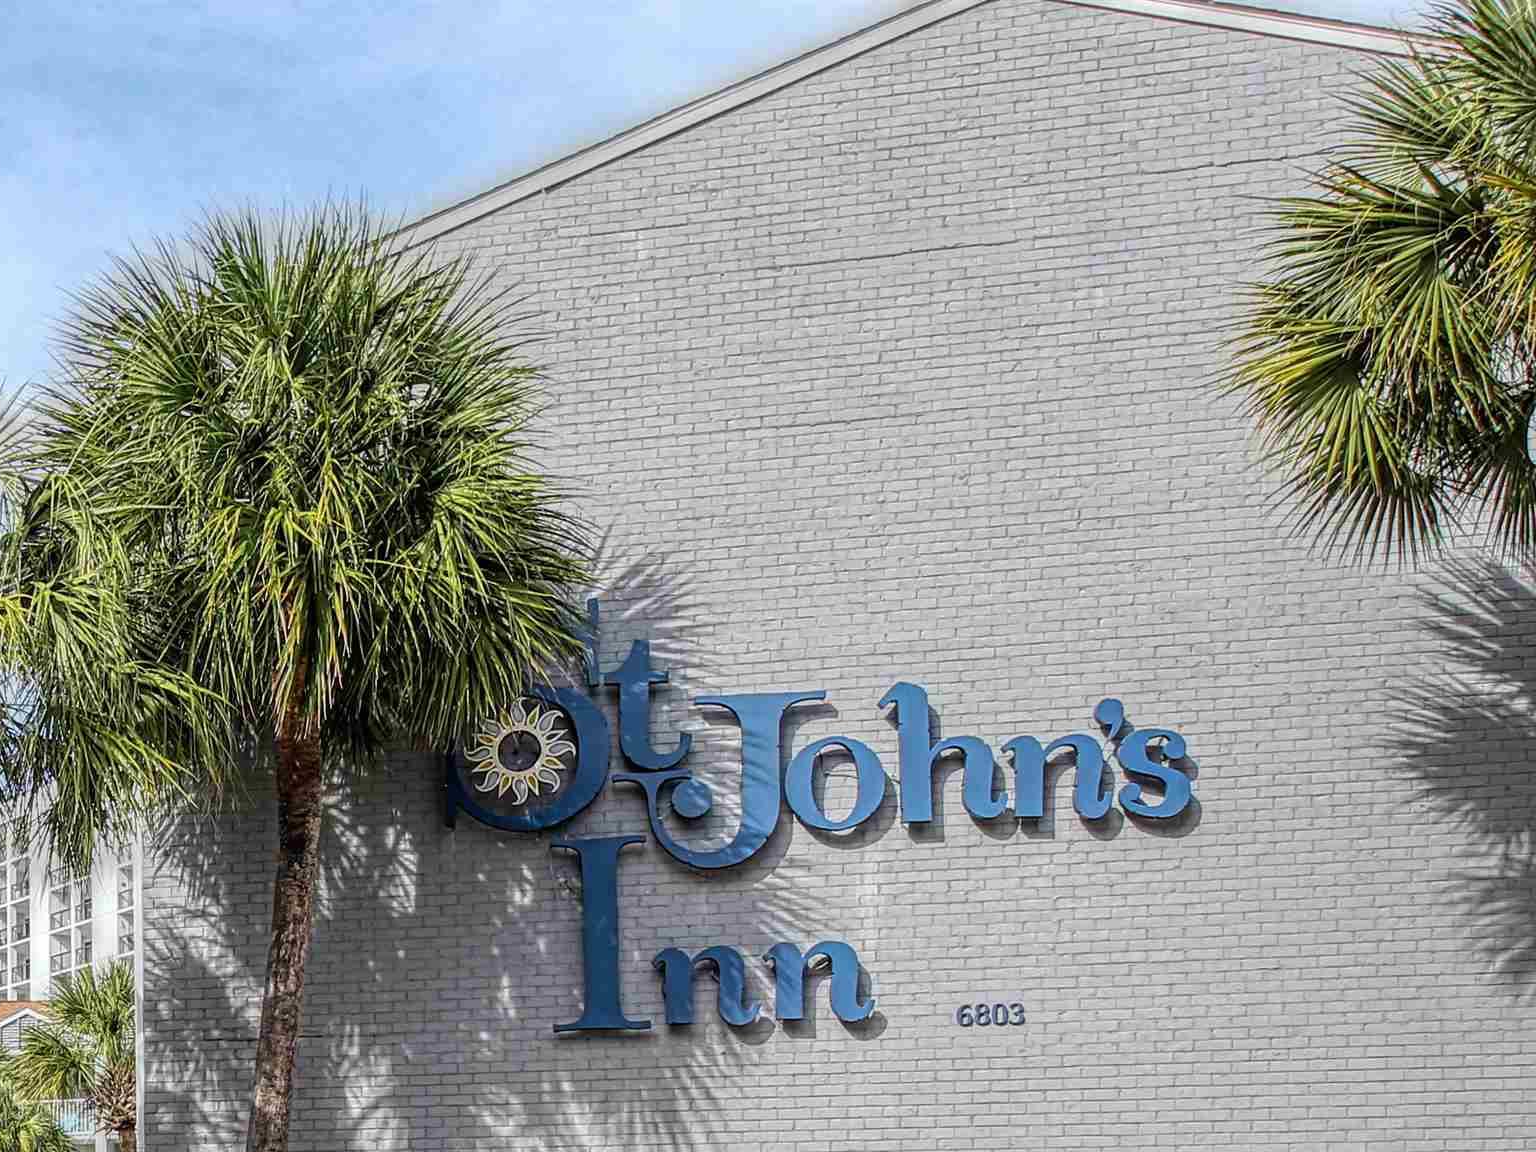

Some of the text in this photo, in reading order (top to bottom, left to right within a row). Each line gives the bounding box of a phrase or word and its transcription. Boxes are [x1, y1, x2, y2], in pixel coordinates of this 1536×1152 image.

[612, 681, 1192, 869] John's
[550, 835, 876, 1034] Inn
[956, 1003, 1026, 1027] 6803
